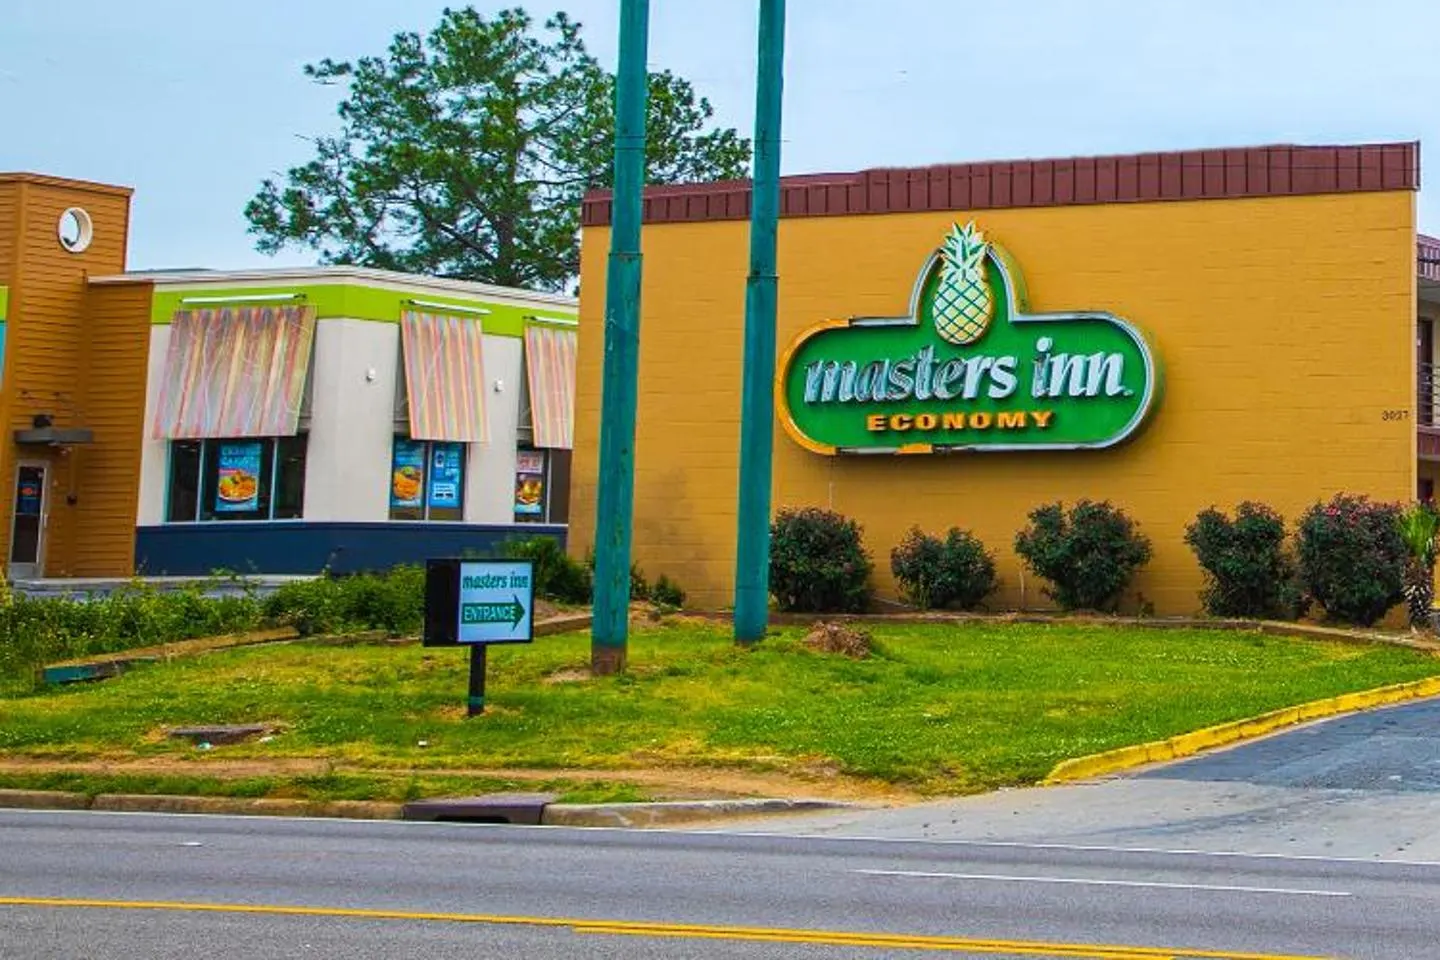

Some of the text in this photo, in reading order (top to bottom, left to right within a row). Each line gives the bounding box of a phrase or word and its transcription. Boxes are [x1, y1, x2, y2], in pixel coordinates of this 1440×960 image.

[803, 345, 1018, 403] masters
[866, 411, 1055, 433] ECONOMY
[462, 571, 529, 590] masters inn
[463, 605, 516, 621] ENTRANCE
